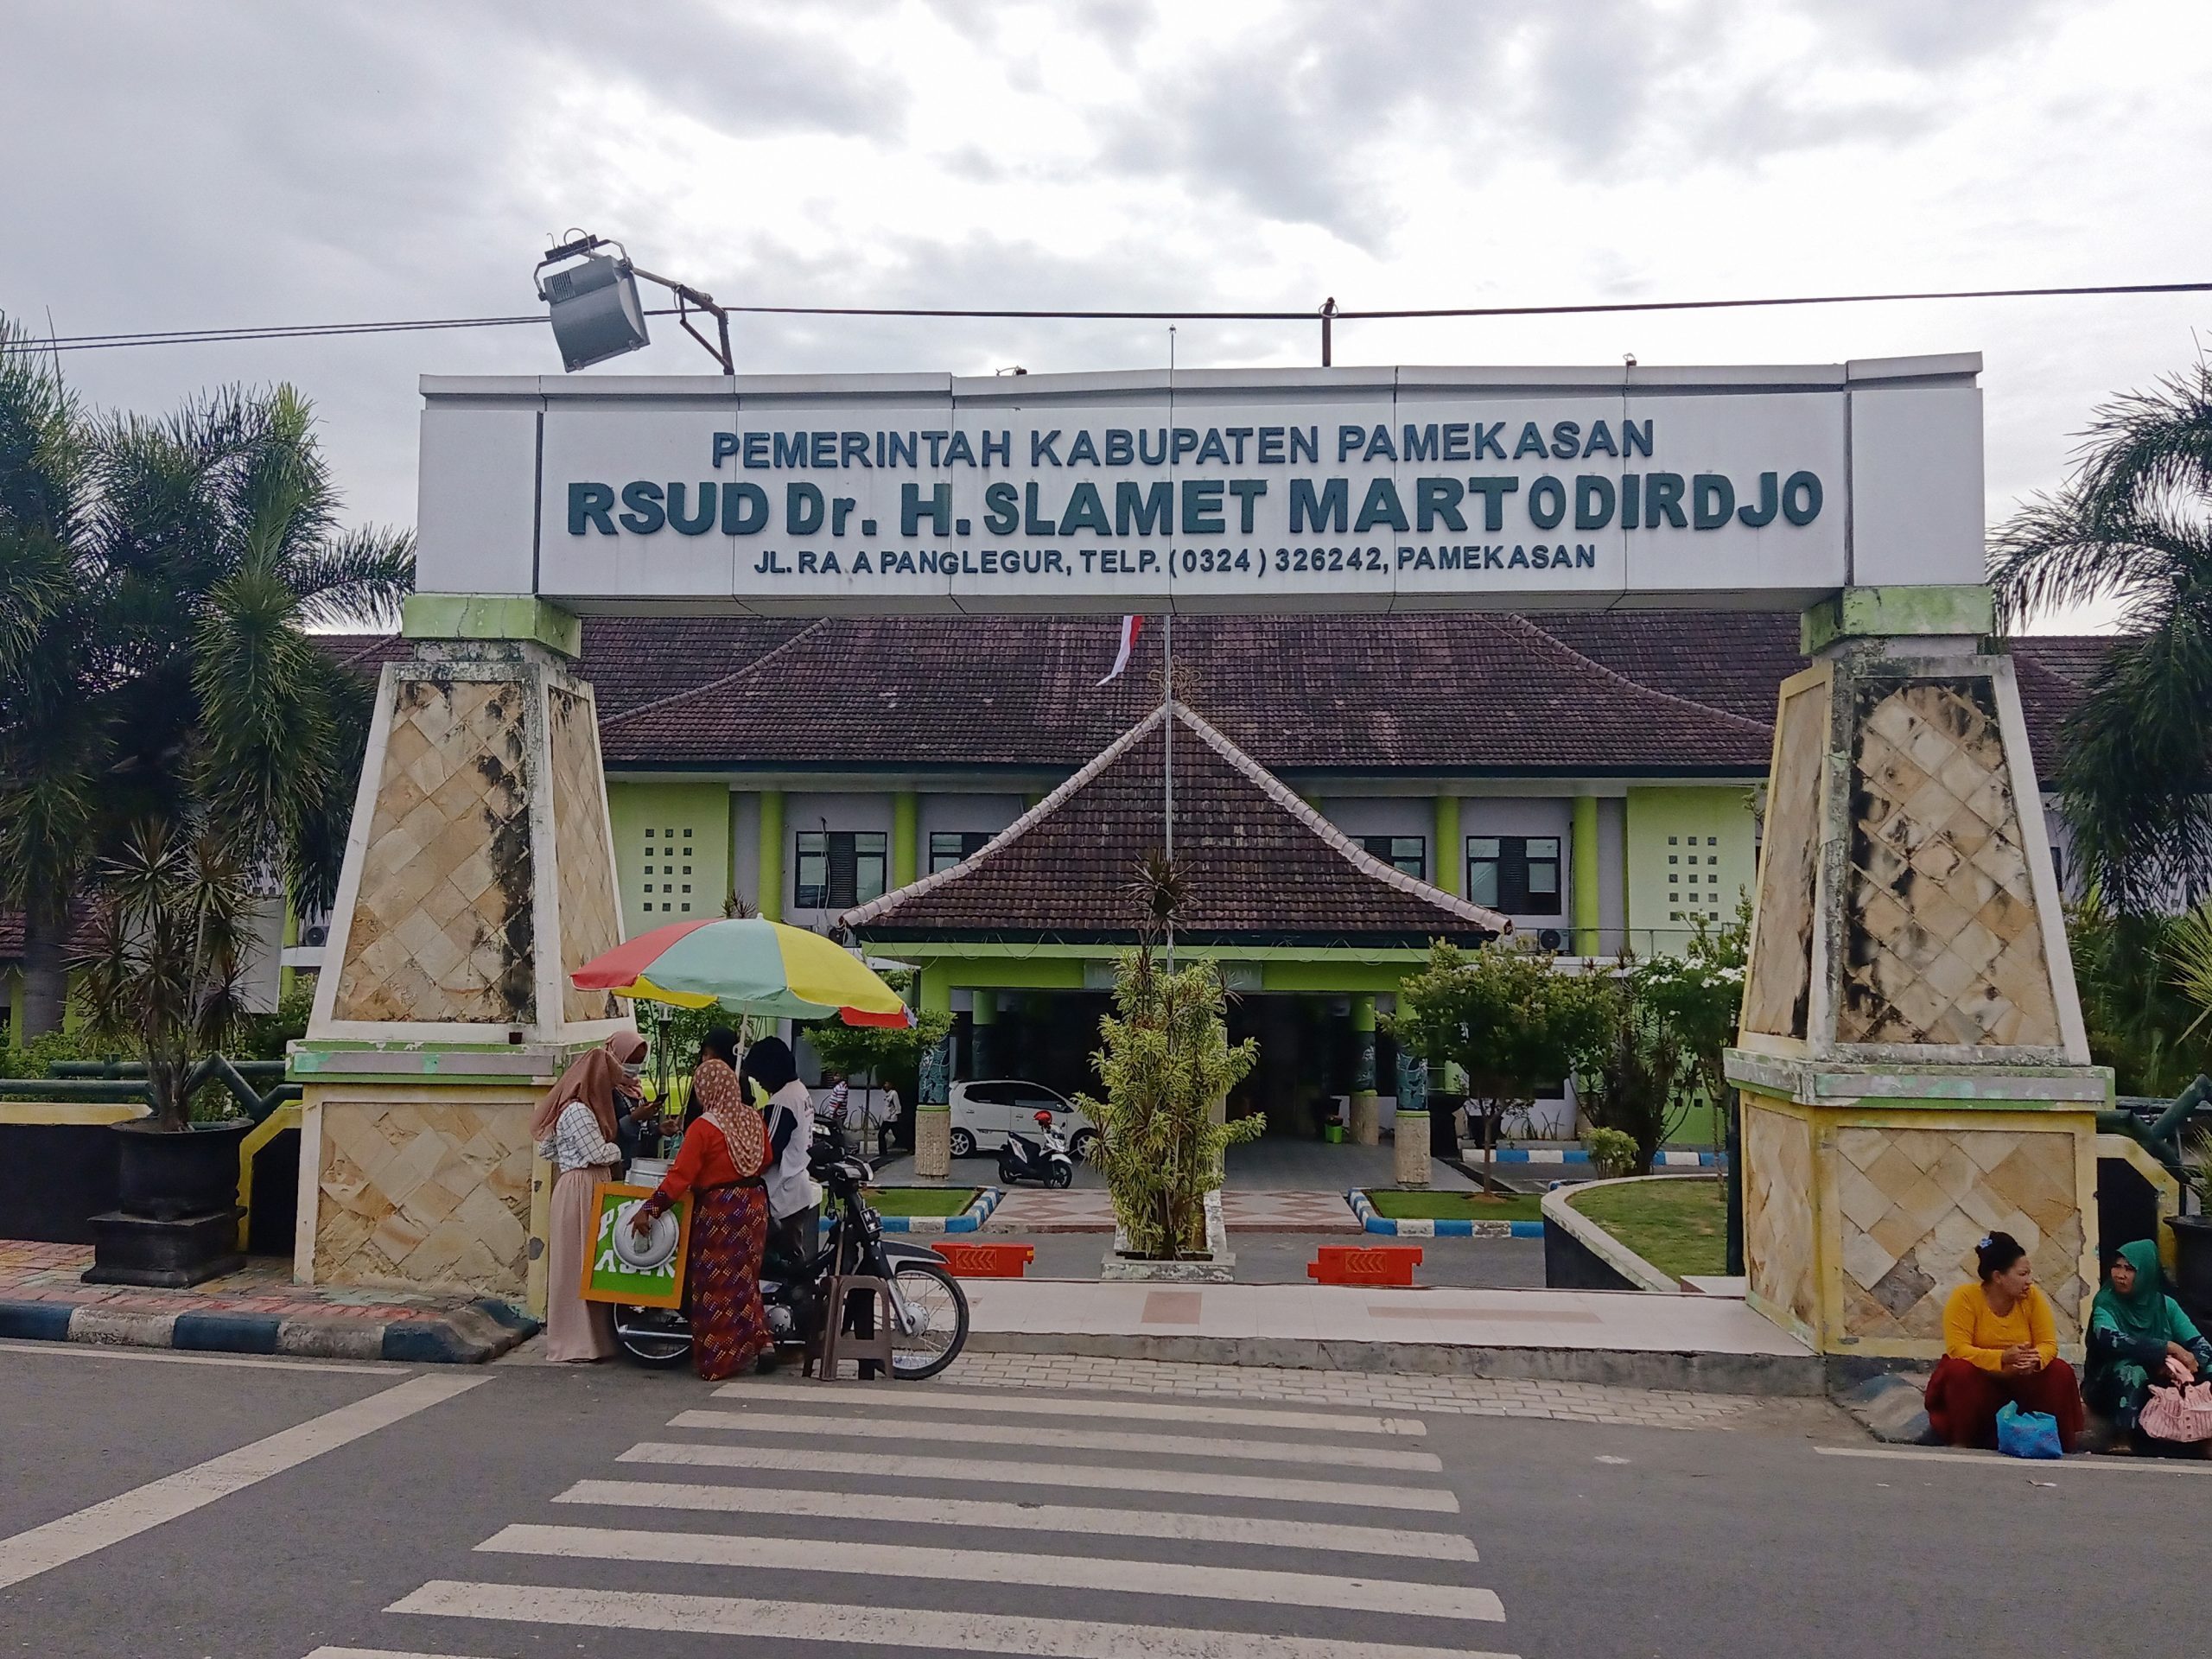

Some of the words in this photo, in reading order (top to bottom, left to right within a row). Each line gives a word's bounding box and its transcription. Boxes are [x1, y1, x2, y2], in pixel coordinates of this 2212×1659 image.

[713, 430, 1011, 471] PEMERINTAH
[1032, 426, 1319, 467] KABUPATEN
[1338, 420, 1654, 463] PAMEKASAN
[568, 482, 770, 538] RSUD
[787, 482, 877, 537] Dr.
[1289, 470, 1823, 534] MARTODIRDJO
[1080, 550, 1161, 574] TELP.
[1275, 546, 1389, 575] 326242,
[1398, 543, 1595, 570] PAMEKASAN
